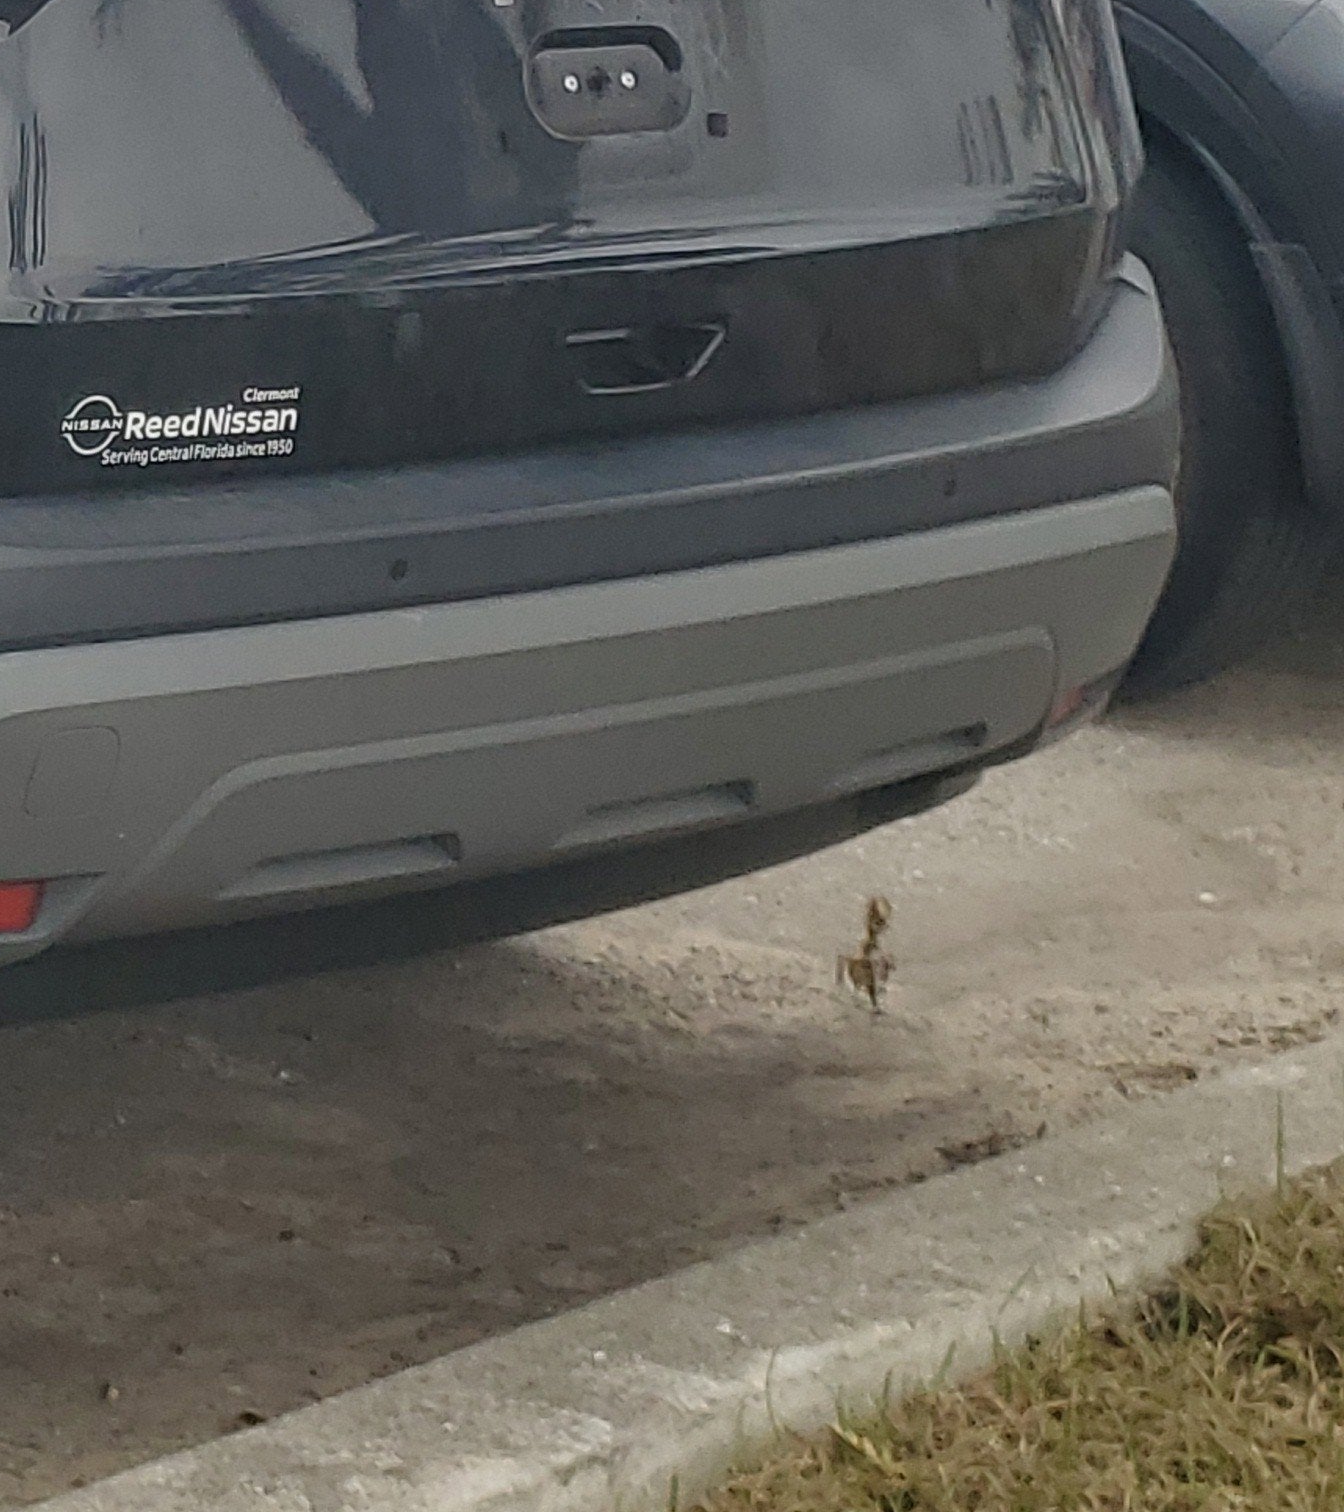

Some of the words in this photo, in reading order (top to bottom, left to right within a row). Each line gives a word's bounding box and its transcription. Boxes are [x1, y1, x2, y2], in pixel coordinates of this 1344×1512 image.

[243, 387, 301, 403] Clermont
[61, 418, 123, 432] NISSAN
[124, 406, 202, 440] Reed
[202, 403, 298, 437] Nissan
[101, 447, 149, 467] Serving
[150, 444, 194, 463] Central
[194, 442, 235, 460] Florida
[235, 441, 266, 458] since
[267, 438, 294, 456] 1950
